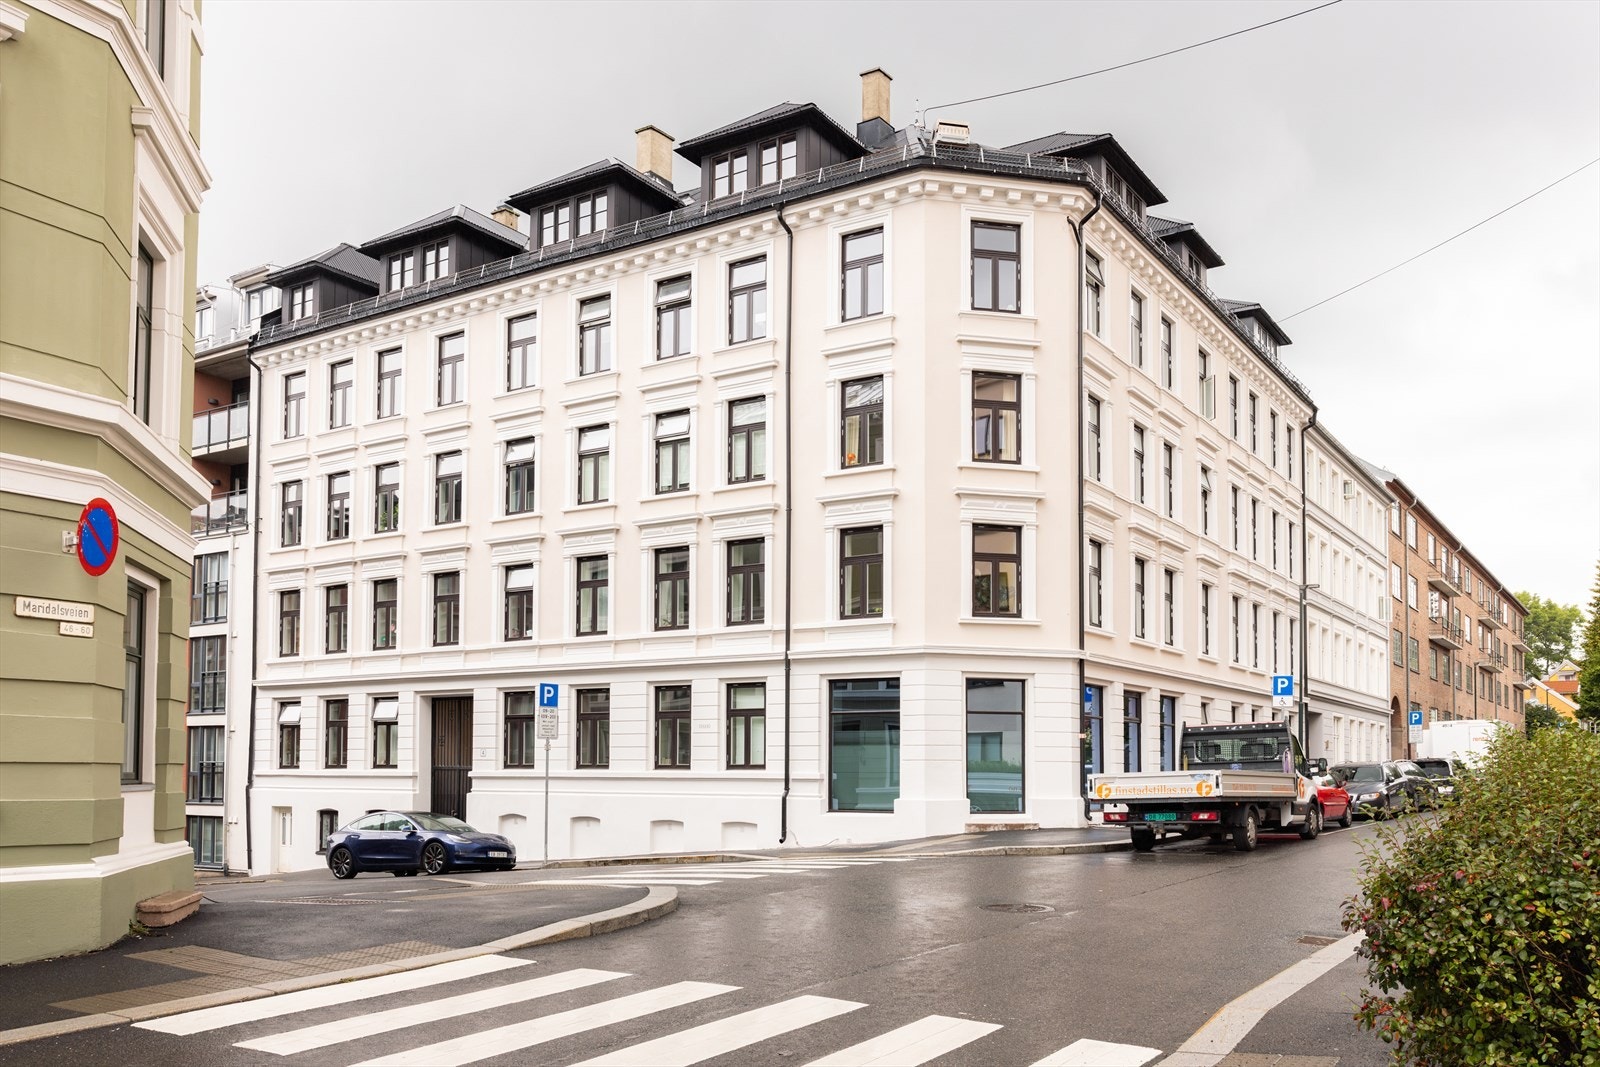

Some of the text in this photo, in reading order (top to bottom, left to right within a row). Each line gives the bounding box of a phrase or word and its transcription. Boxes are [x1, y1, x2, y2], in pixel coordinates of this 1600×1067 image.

[22, 600, 89, 618] Maridalsveien
[1278, 678, 1289, 694] P
[543, 686, 555, 704] P
[1411, 713, 1420, 724] P
[1115, 785, 1193, 796] finstadstillas.no
